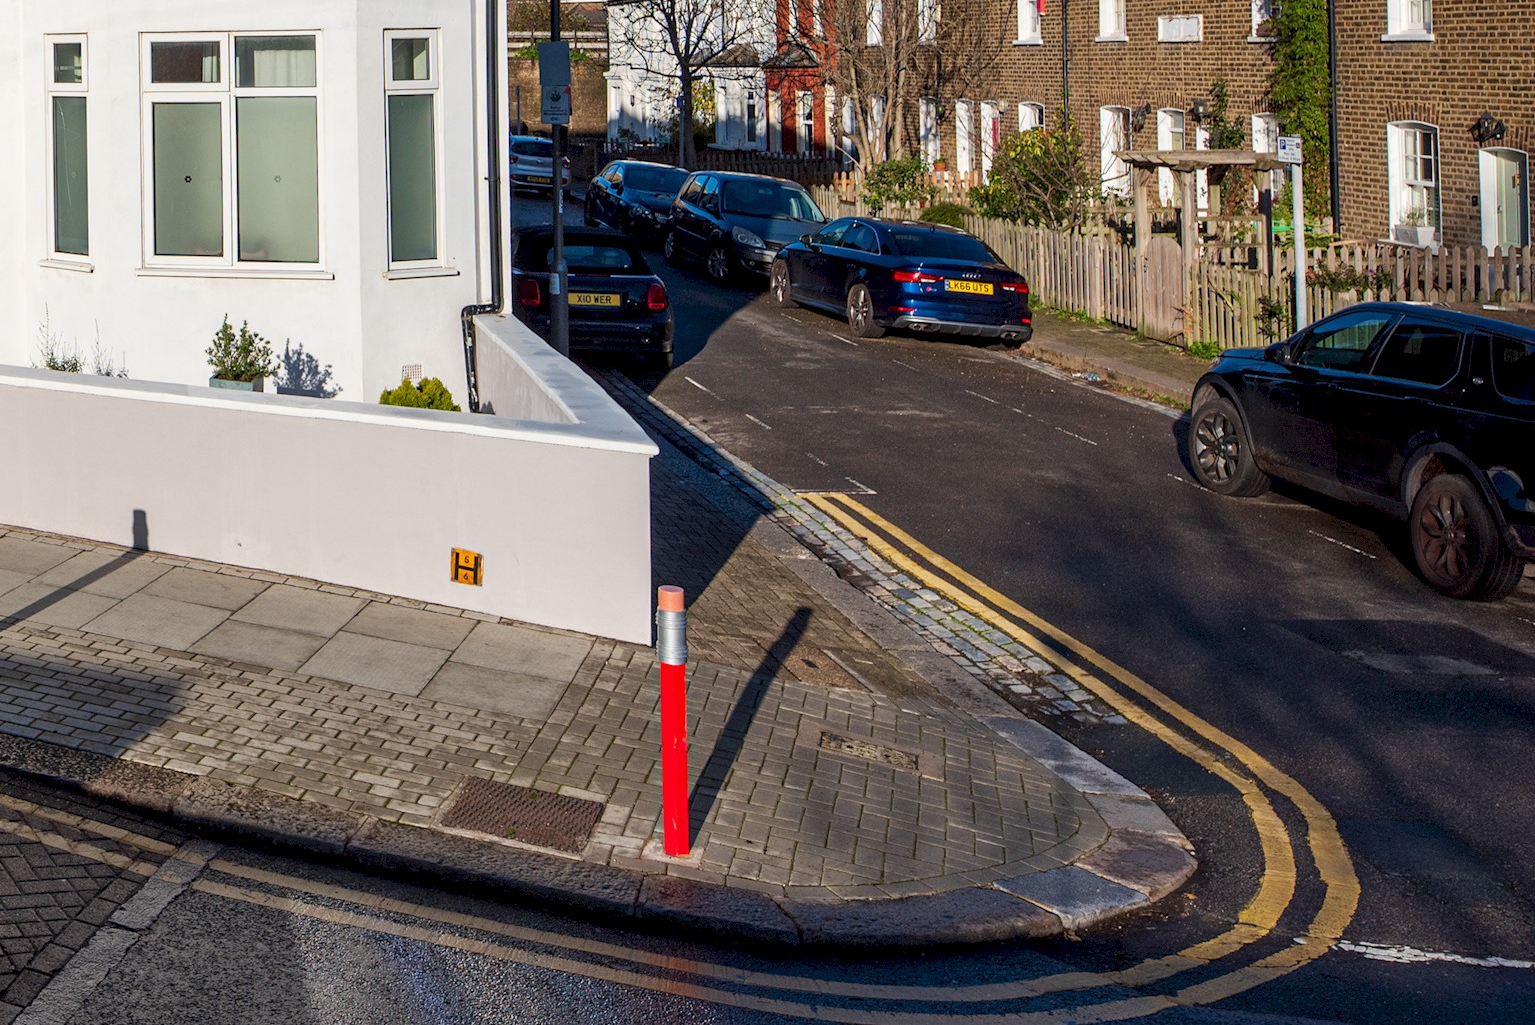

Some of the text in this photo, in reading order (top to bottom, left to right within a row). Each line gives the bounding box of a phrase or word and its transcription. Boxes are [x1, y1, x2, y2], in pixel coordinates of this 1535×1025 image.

[948, 280, 971, 291] LK66
[973, 282, 989, 293] UTS
[594, 295, 612, 305] WER
[454, 551, 479, 586] H
[463, 572, 469, 580] 6
